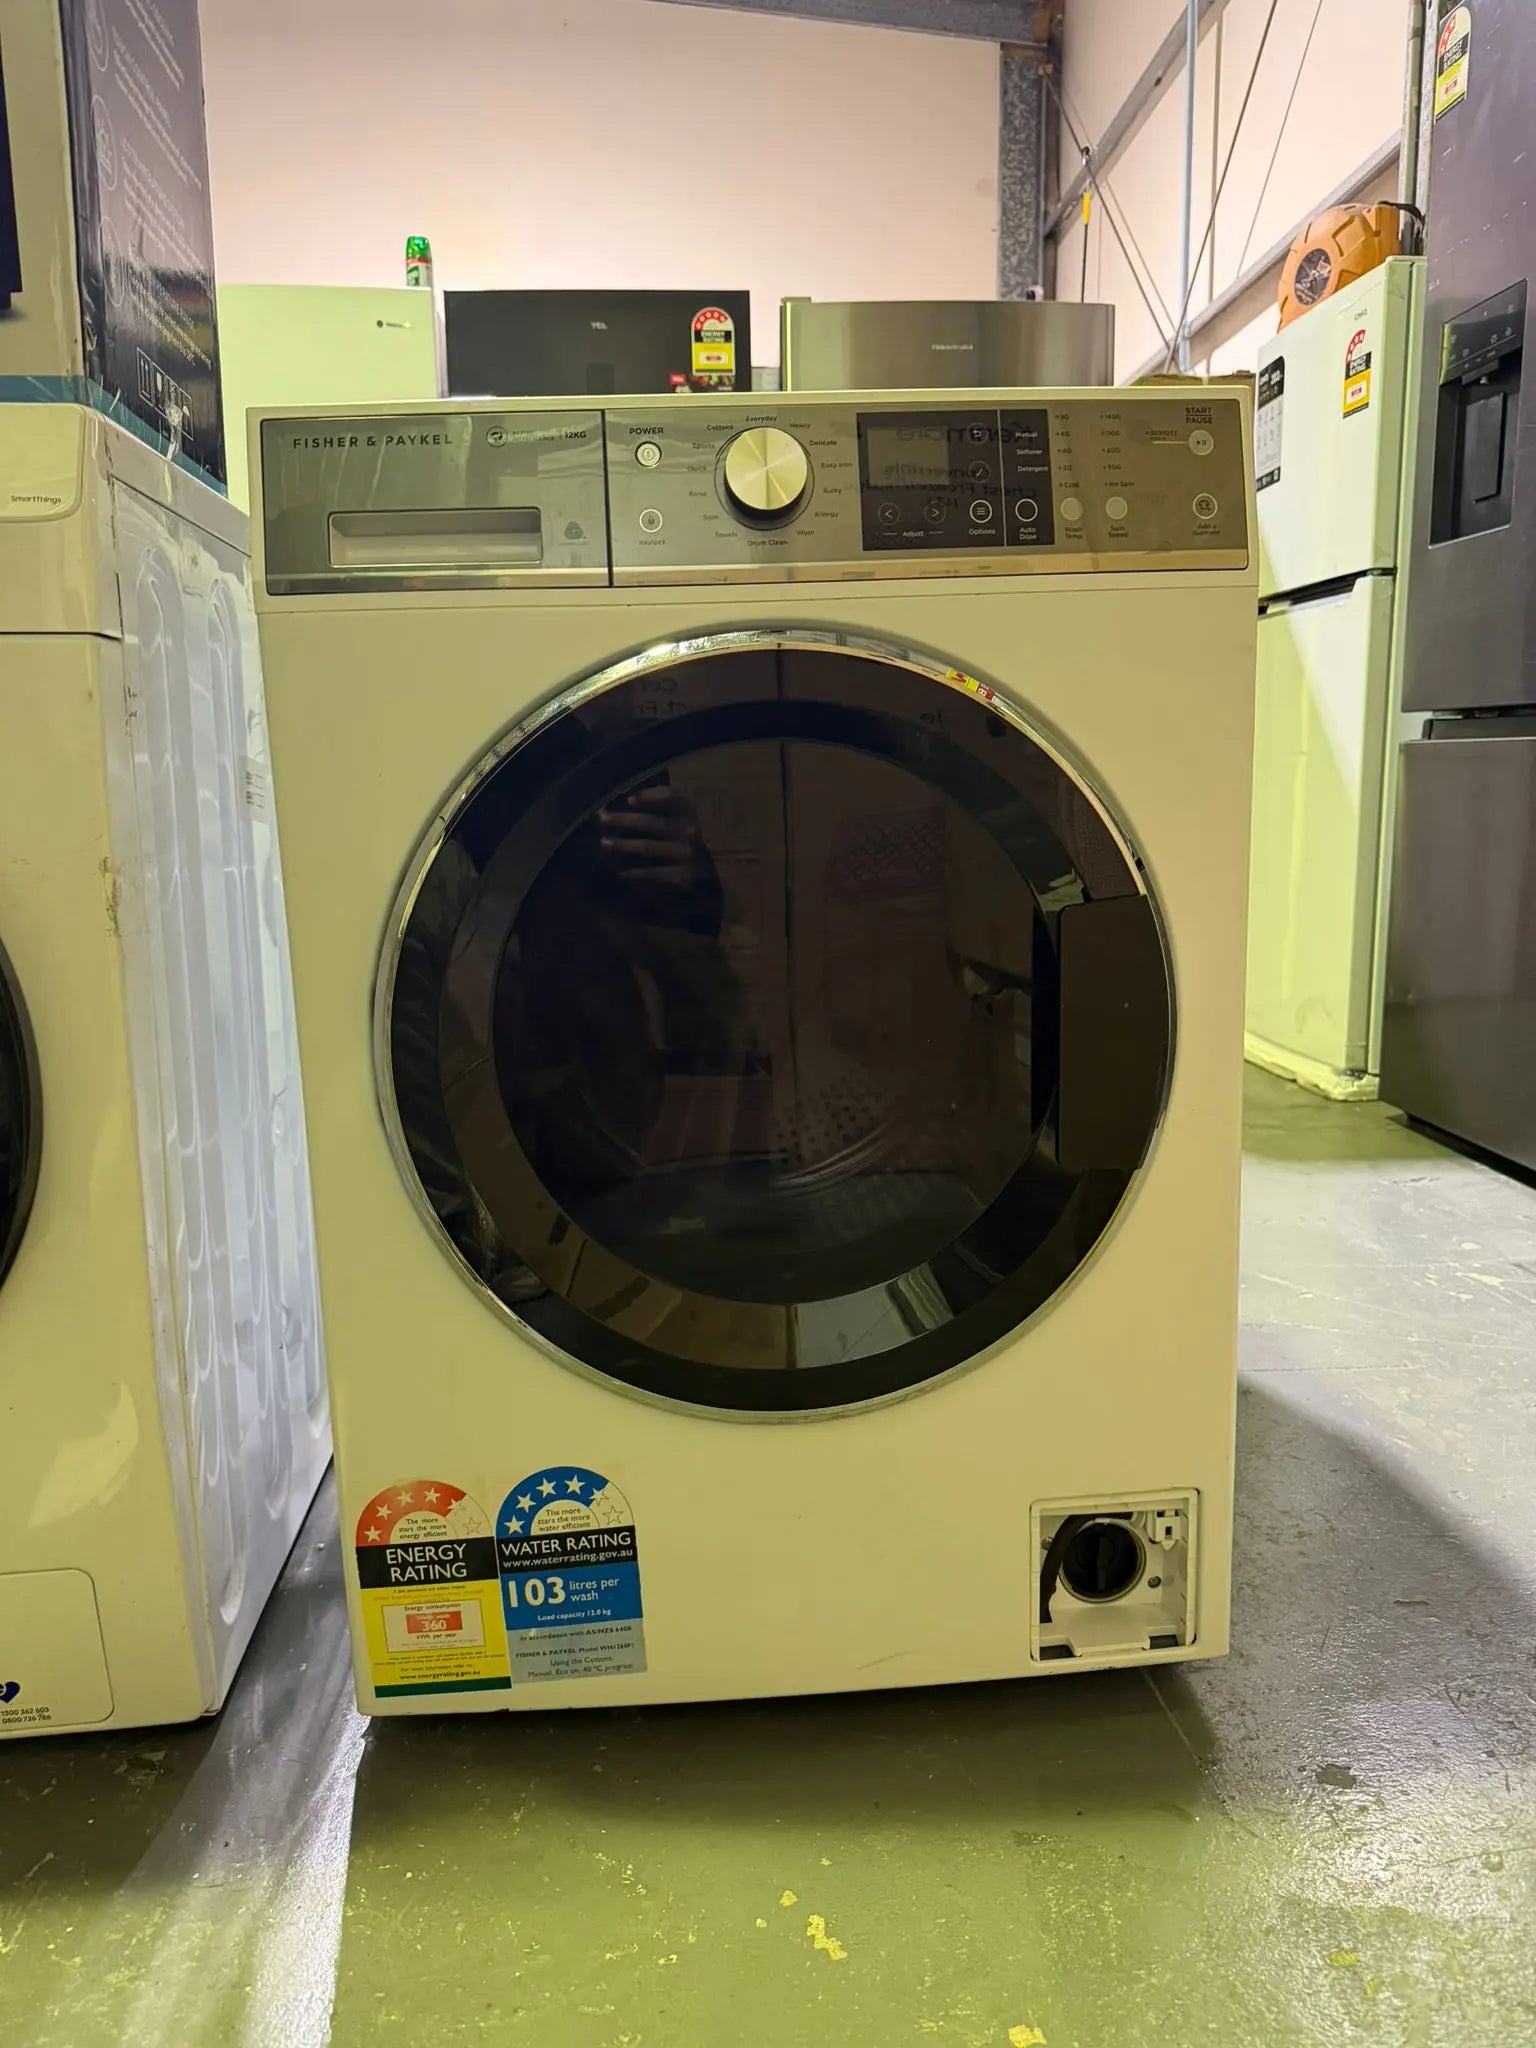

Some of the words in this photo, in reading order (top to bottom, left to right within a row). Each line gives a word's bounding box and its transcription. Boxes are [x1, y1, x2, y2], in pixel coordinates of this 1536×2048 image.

[746, 415, 777, 423] Everyday
[565, 430, 587, 439] 12KG
[629, 427, 664, 435] POWER
[293, 436, 358, 449] FISHER
[366, 437, 377, 447] &
[385, 433, 453, 446] PAYKEL
[823, 487, 842, 495] Bulky
[11, 494, 62, 505] SmartThings
[815, 511, 839, 519] Allergy
[902, 530, 924, 538] Adjust
[969, 528, 996, 536] Options
[1110, 525, 1126, 533] Spin
[639, 538, 666, 547] Keylock
[562, 1521, 591, 1530] efficient
[501, 1539, 562, 1556] WATER
[566, 1531, 631, 1551] RATING
[386, 1543, 466, 1565] ENERGY
[503, 1548, 633, 1569] www.waterrating.gov.au
[390, 1562, 467, 1582] RATING
[569, 1579, 597, 1591] litres
[600, 1577, 620, 1591] per
[508, 1576, 566, 1608] 103
[570, 1591, 599, 1602] wash
[404, 1604, 423, 1612] Energy
[426, 1602, 461, 1610] consumption
[557, 1611, 585, 1620] capacity
[587, 1609, 601, 1617] 12.0
[602, 1608, 612, 1616] kg
[421, 1620, 447, 1632] 360
[416, 1632, 431, 1640] kWh
[445, 1632, 457, 1640] year
[528, 1631, 568, 1641] accordance
[570, 1629, 585, 1637] with
[515, 1651, 541, 1659] FISHER
[549, 1648, 577, 1656] PAYKEL
[579, 1645, 598, 1653] Model
[550, 1659, 569, 1667] Using
[400, 1669, 481, 1680] www.energyrating.gov.au
[556, 1668, 568, 1676] Eco
[604, 1662, 633, 1673] program
[1, 1709, 20, 1717] 1300
[35, 1706, 50, 1714] 603
